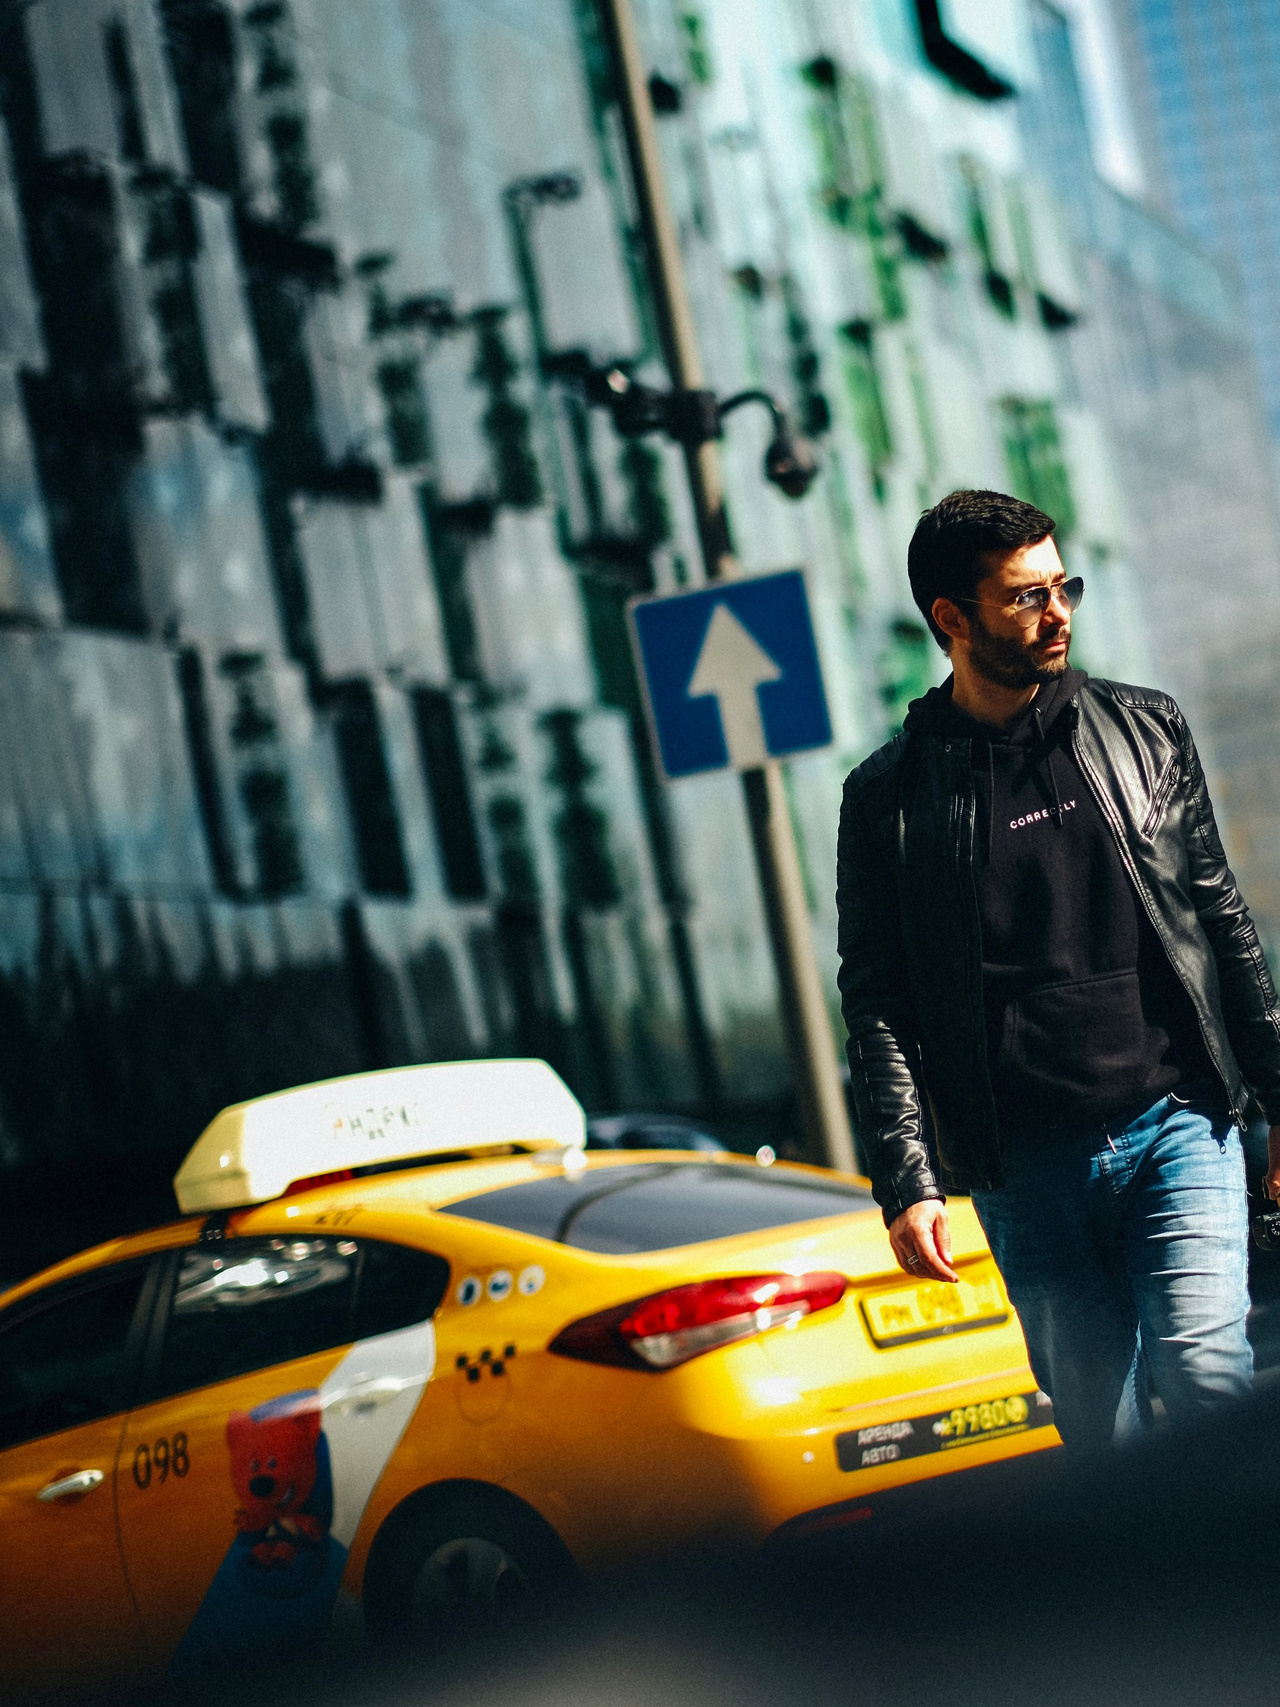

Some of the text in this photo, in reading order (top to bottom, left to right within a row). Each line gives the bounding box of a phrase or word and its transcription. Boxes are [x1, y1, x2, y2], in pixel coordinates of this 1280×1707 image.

[857, 1420, 915, 1446] АРЕНДА
[132, 1431, 190, 1490] 098
[861, 1443, 901, 1466] АВТО
